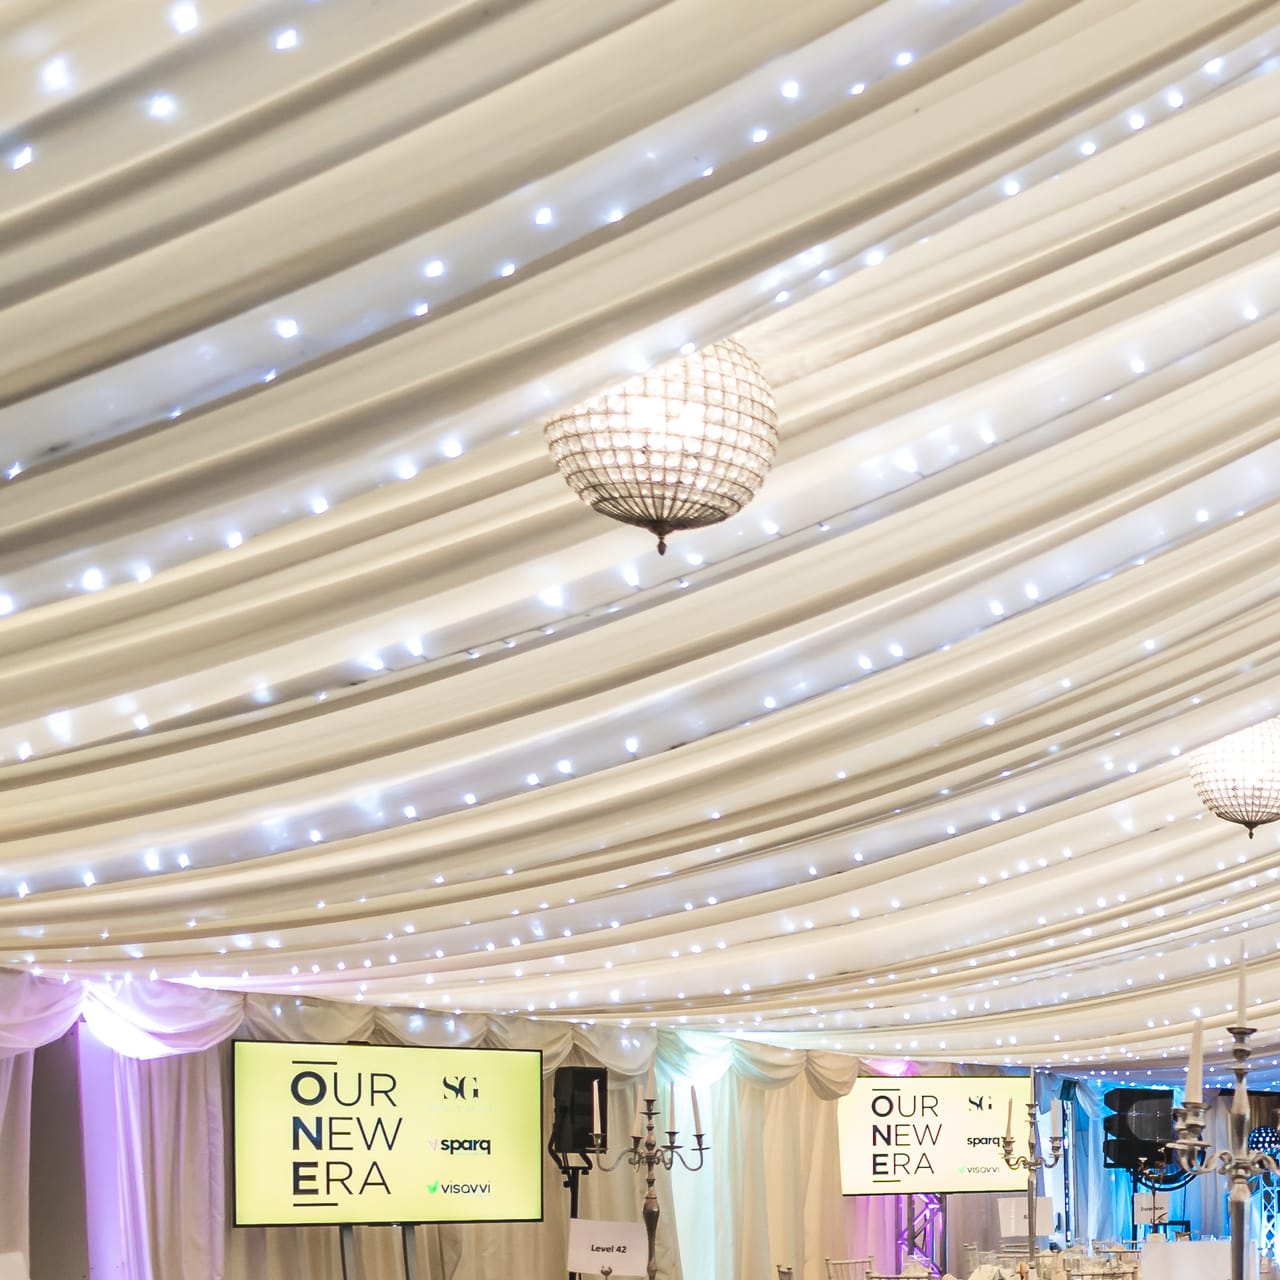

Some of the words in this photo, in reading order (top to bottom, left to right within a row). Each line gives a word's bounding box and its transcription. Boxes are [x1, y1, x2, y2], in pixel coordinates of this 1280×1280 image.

[290, 1070, 397, 1107] OUR
[871, 1095, 939, 1117] OUR
[292, 1116, 403, 1151] NEW
[872, 1124, 942, 1146] NEW
[967, 1137, 1000, 1148] sparq
[441, 1139, 491, 1155] sparq
[872, 1152, 935, 1175] ERA
[292, 1161, 392, 1195] ERA
[441, 1180, 491, 1194] visavvi
[591, 1244, 614, 1253] Level
